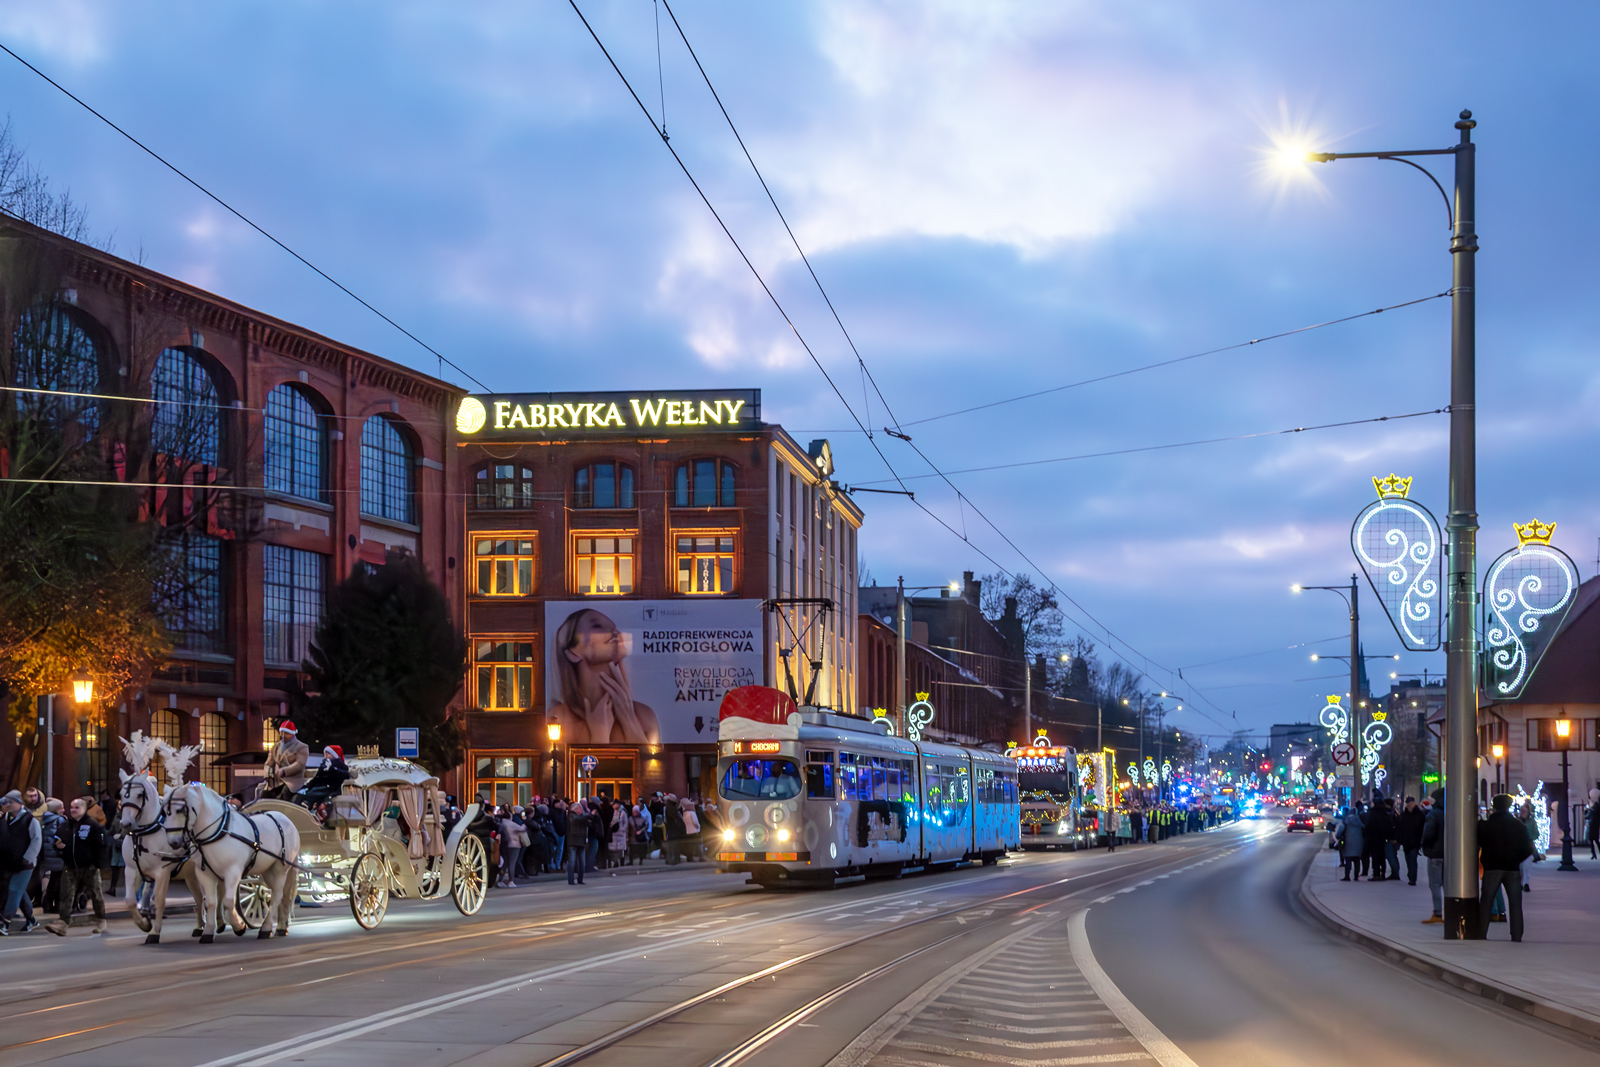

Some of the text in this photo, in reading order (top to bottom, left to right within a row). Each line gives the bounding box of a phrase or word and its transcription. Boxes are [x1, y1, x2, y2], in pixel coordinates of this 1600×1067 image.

[642, 630, 754, 640] RADIOFREKWENCJA
[642, 640, 755, 653] MIKROIGŁOWA
[674, 667, 754, 678] REWOLUCJA
[674, 679, 686, 688] W
